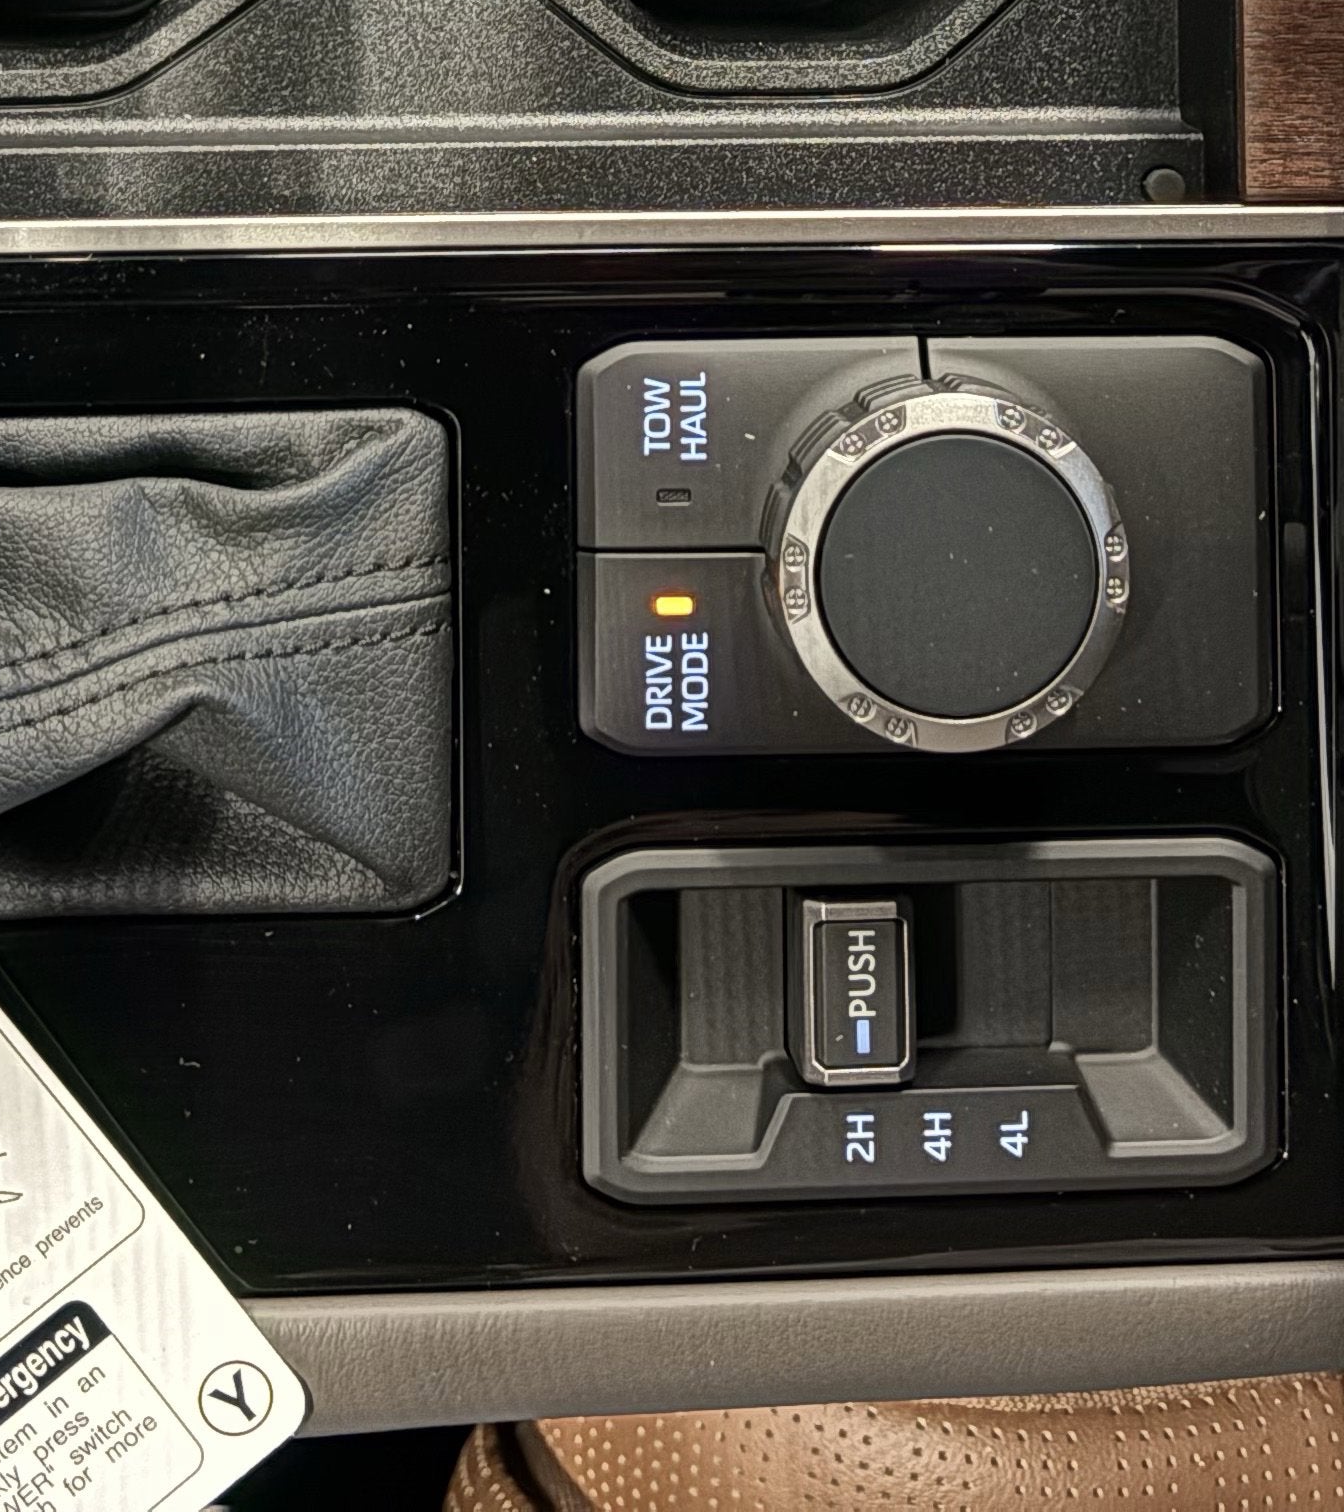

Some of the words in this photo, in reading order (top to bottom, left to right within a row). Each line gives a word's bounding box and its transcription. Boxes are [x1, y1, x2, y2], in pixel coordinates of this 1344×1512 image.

[644, 378, 670, 456] TOW
[679, 372, 707, 460] HAUL
[646, 635, 672, 729] DRIVE
[682, 632, 708, 731] MODE
[848, 931, 876, 1017] PUSH
[846, 1115, 874, 1162] 2H
[923, 1113, 952, 1161] 4H
[1000, 1111, 1028, 1157] 4L
[35, 1196, 103, 1259] prevents
[43, 1396, 69, 1418] in
[77, 1366, 106, 1393] an
[208, 1370, 257, 1422] Y
[32, 1411, 94, 1467] press
[62, 1466, 92, 1497] for
[104, 1415, 157, 1463] more
[69, 1409, 132, 1465] switch
